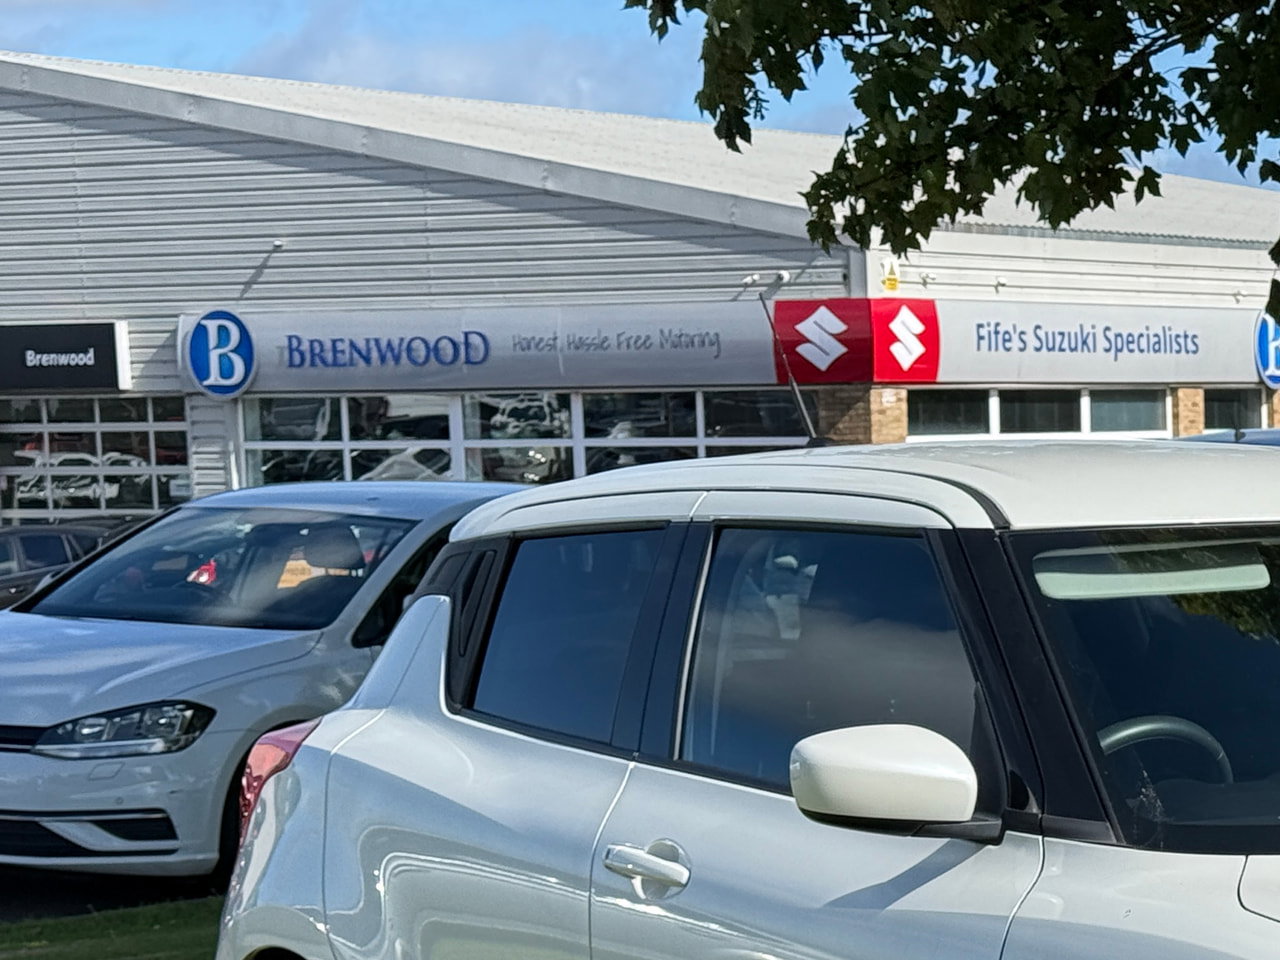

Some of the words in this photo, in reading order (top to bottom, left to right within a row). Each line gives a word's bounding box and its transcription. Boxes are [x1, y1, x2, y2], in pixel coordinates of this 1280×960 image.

[25, 347, 95, 367] Brenwood
[201, 319, 246, 387] B
[286, 330, 490, 368] BRENWOOD
[566, 328, 610, 351] Hassle
[615, 331, 653, 350] Free
[658, 328, 721, 359] Motoring
[975, 322, 1027, 352] Fife's
[1033, 324, 1097, 353] Suzuki
[1102, 326, 1200, 362] Specialists
